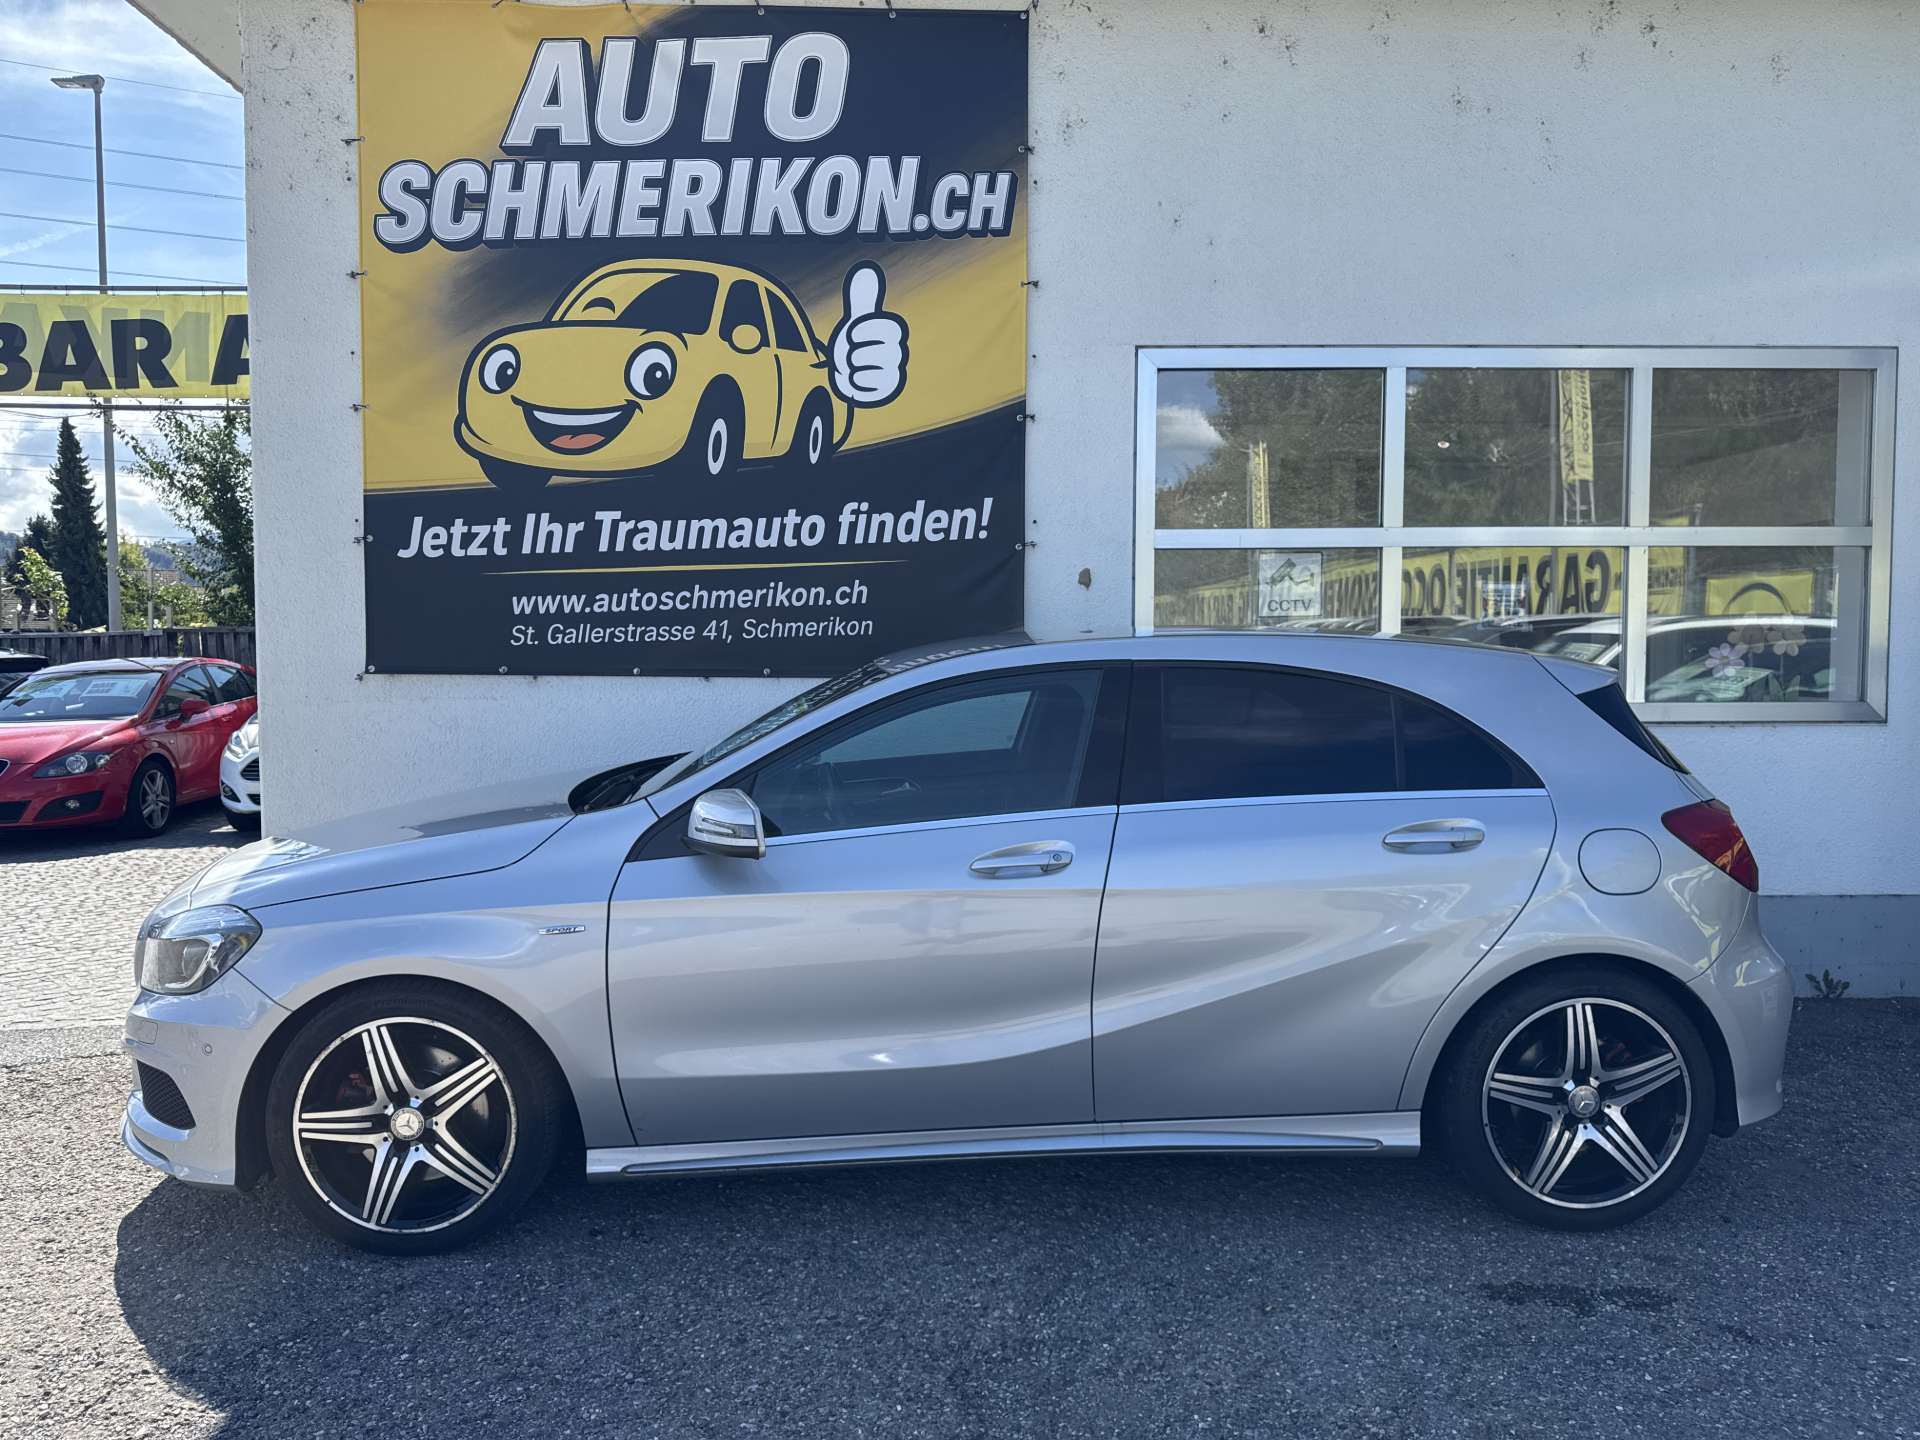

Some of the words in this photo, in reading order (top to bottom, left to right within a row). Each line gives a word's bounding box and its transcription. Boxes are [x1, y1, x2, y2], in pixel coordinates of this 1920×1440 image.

[502, 31, 850, 148] AUTO
[375, 154, 1014, 245] SCHMERIKON.CH
[397, 516, 512, 558] Jetzt
[521, 512, 585, 554] Ihr
[594, 508, 826, 552] Traumauto
[837, 497, 994, 545] finden!
[512, 580, 868, 615] www.autoschmerikon.ch
[1267, 598, 1312, 613] CCTV
[510, 626, 539, 646] St.
[547, 623, 696, 645] Gallerstrasse
[702, 619, 732, 643] 41,
[742, 616, 873, 639] Schmerikon
[545, 926, 579, 935] SPORT
